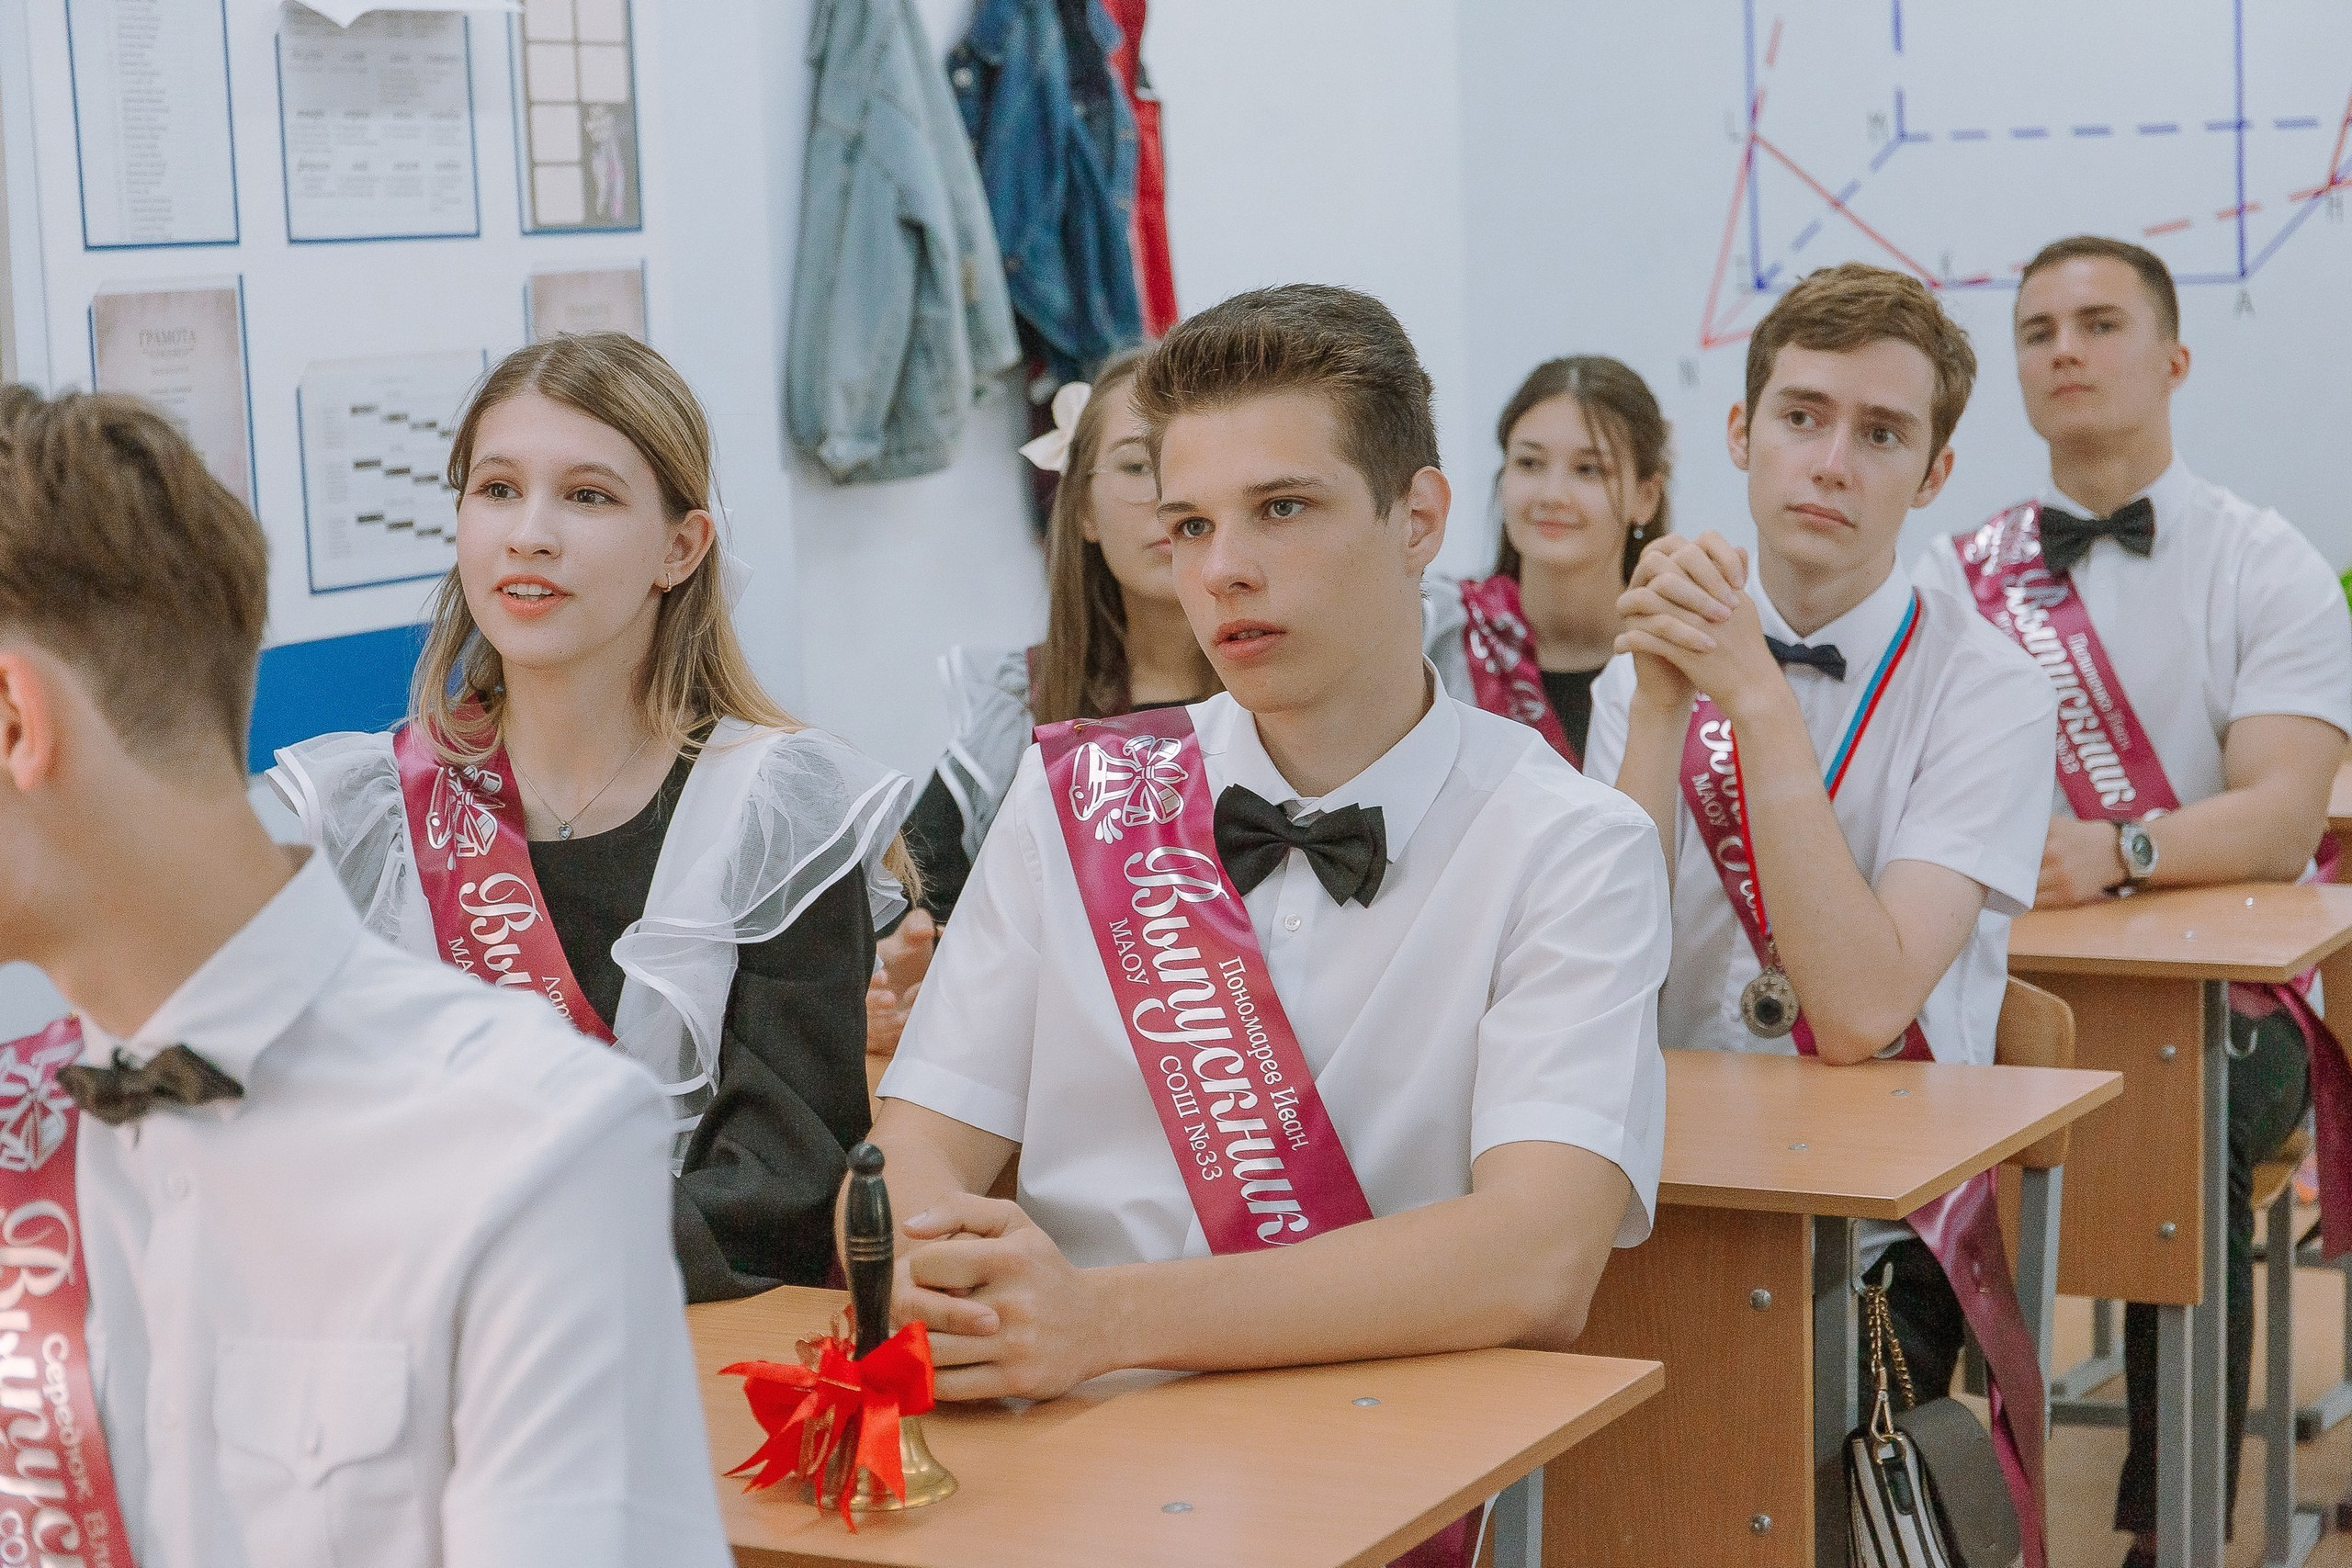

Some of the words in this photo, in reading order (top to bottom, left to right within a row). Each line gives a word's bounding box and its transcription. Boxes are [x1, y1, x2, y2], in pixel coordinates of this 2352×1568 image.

[2236, 288, 2256, 318] A
[458, 872, 544, 995] Вы
[541, 976, 577, 1026] Лар
[1109, 917, 1149, 986] МАОУ
[1159, 1054, 1199, 1120] СОШ
[1184, 1121, 1223, 1181] №33
[1124, 845, 1310, 1247] Выпускник
[1217, 955, 1284, 1085] Пономарев
[1269, 1086, 1310, 1152] Иван
[41, 1334, 93, 1501] Середюк
[0, 1509, 32, 1568] СО
